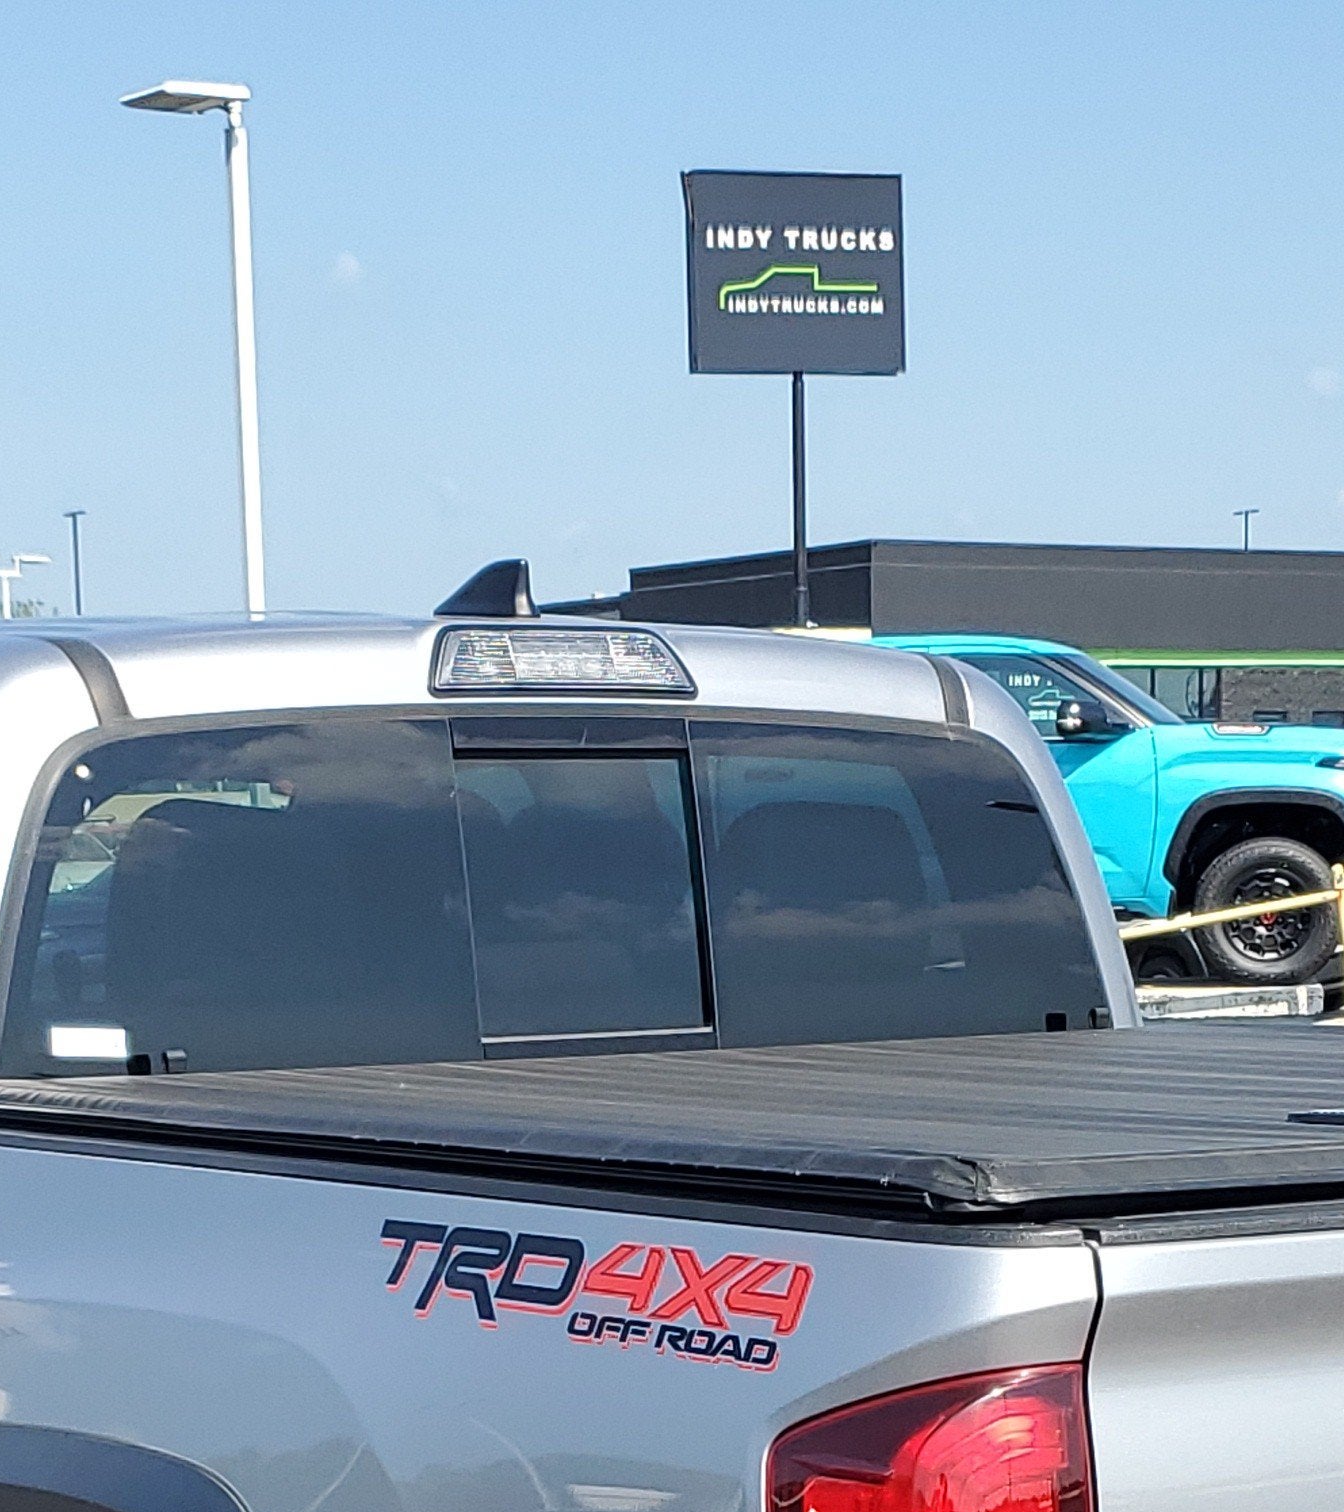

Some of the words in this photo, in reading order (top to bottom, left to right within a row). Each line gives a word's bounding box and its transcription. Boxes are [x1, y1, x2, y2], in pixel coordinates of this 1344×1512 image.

[706, 226, 772, 249] INDY
[783, 227, 895, 251] TRUCKS
[727, 296, 884, 314] INDYTRUCKS.COM
[1009, 674, 1040, 686] INDY
[380, 1219, 586, 1330] TRD
[567, 1311, 652, 1349] OFF
[654, 1323, 780, 1373] ROAD
